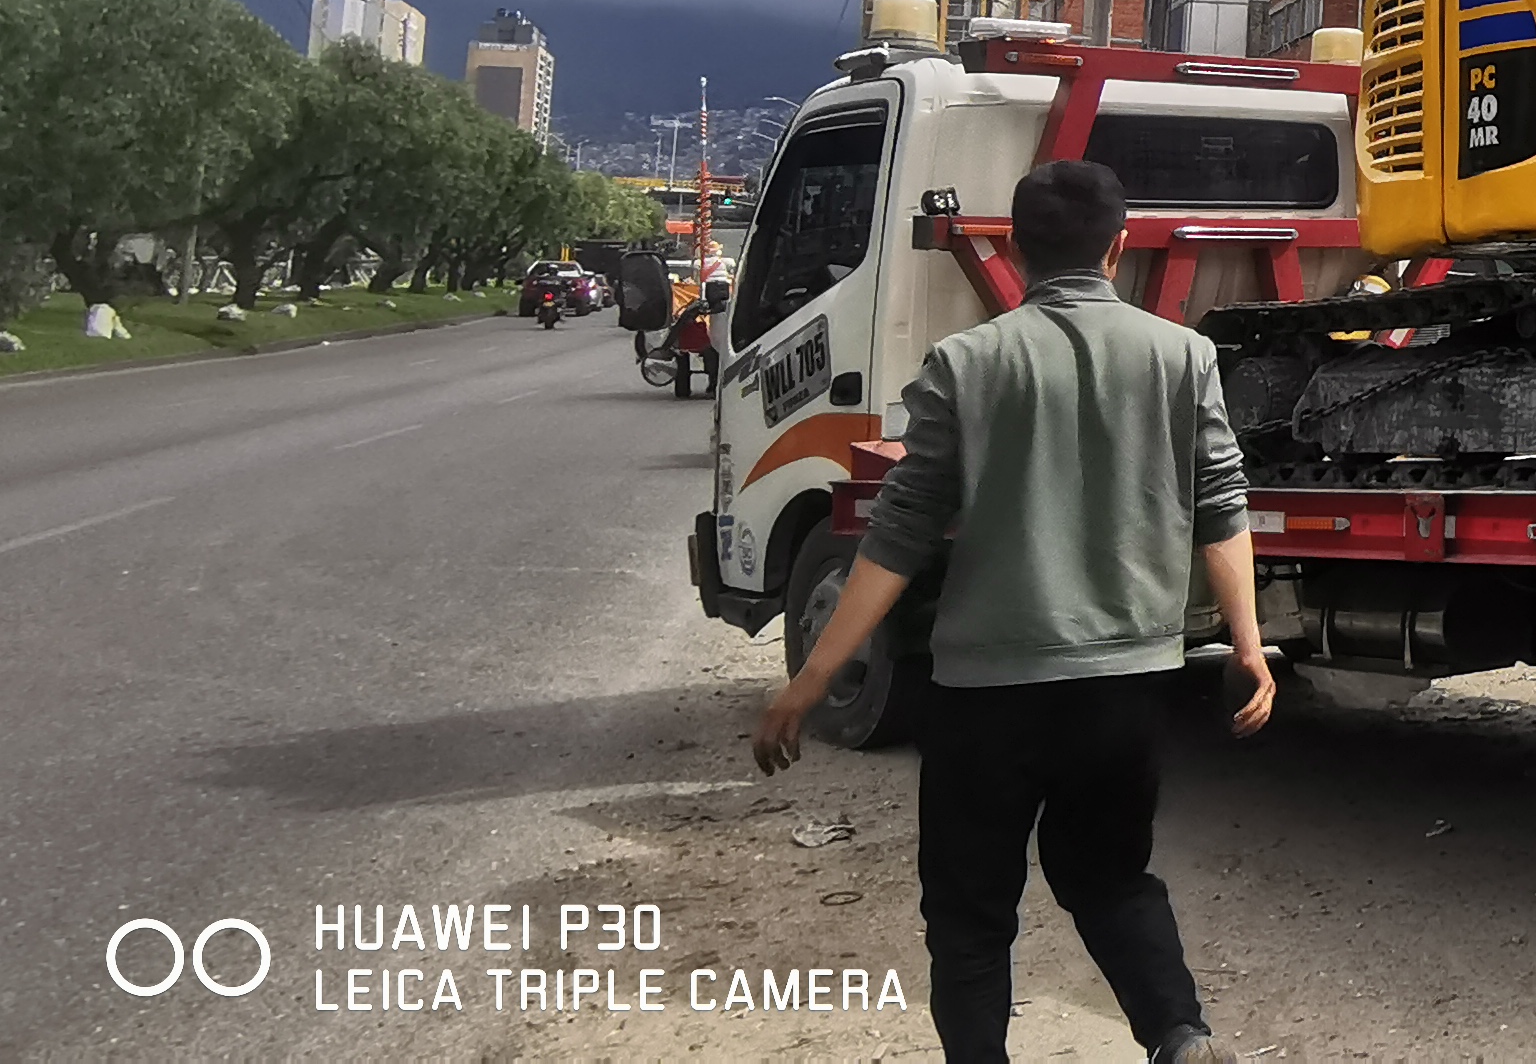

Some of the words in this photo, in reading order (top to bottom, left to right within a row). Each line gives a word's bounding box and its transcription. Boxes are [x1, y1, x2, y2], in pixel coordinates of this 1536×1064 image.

[1470, 64, 1496, 92] PC
[1466, 94, 1498, 124] 40
[1468, 125, 1499, 148] MR
[796, 332, 826, 383] 705
